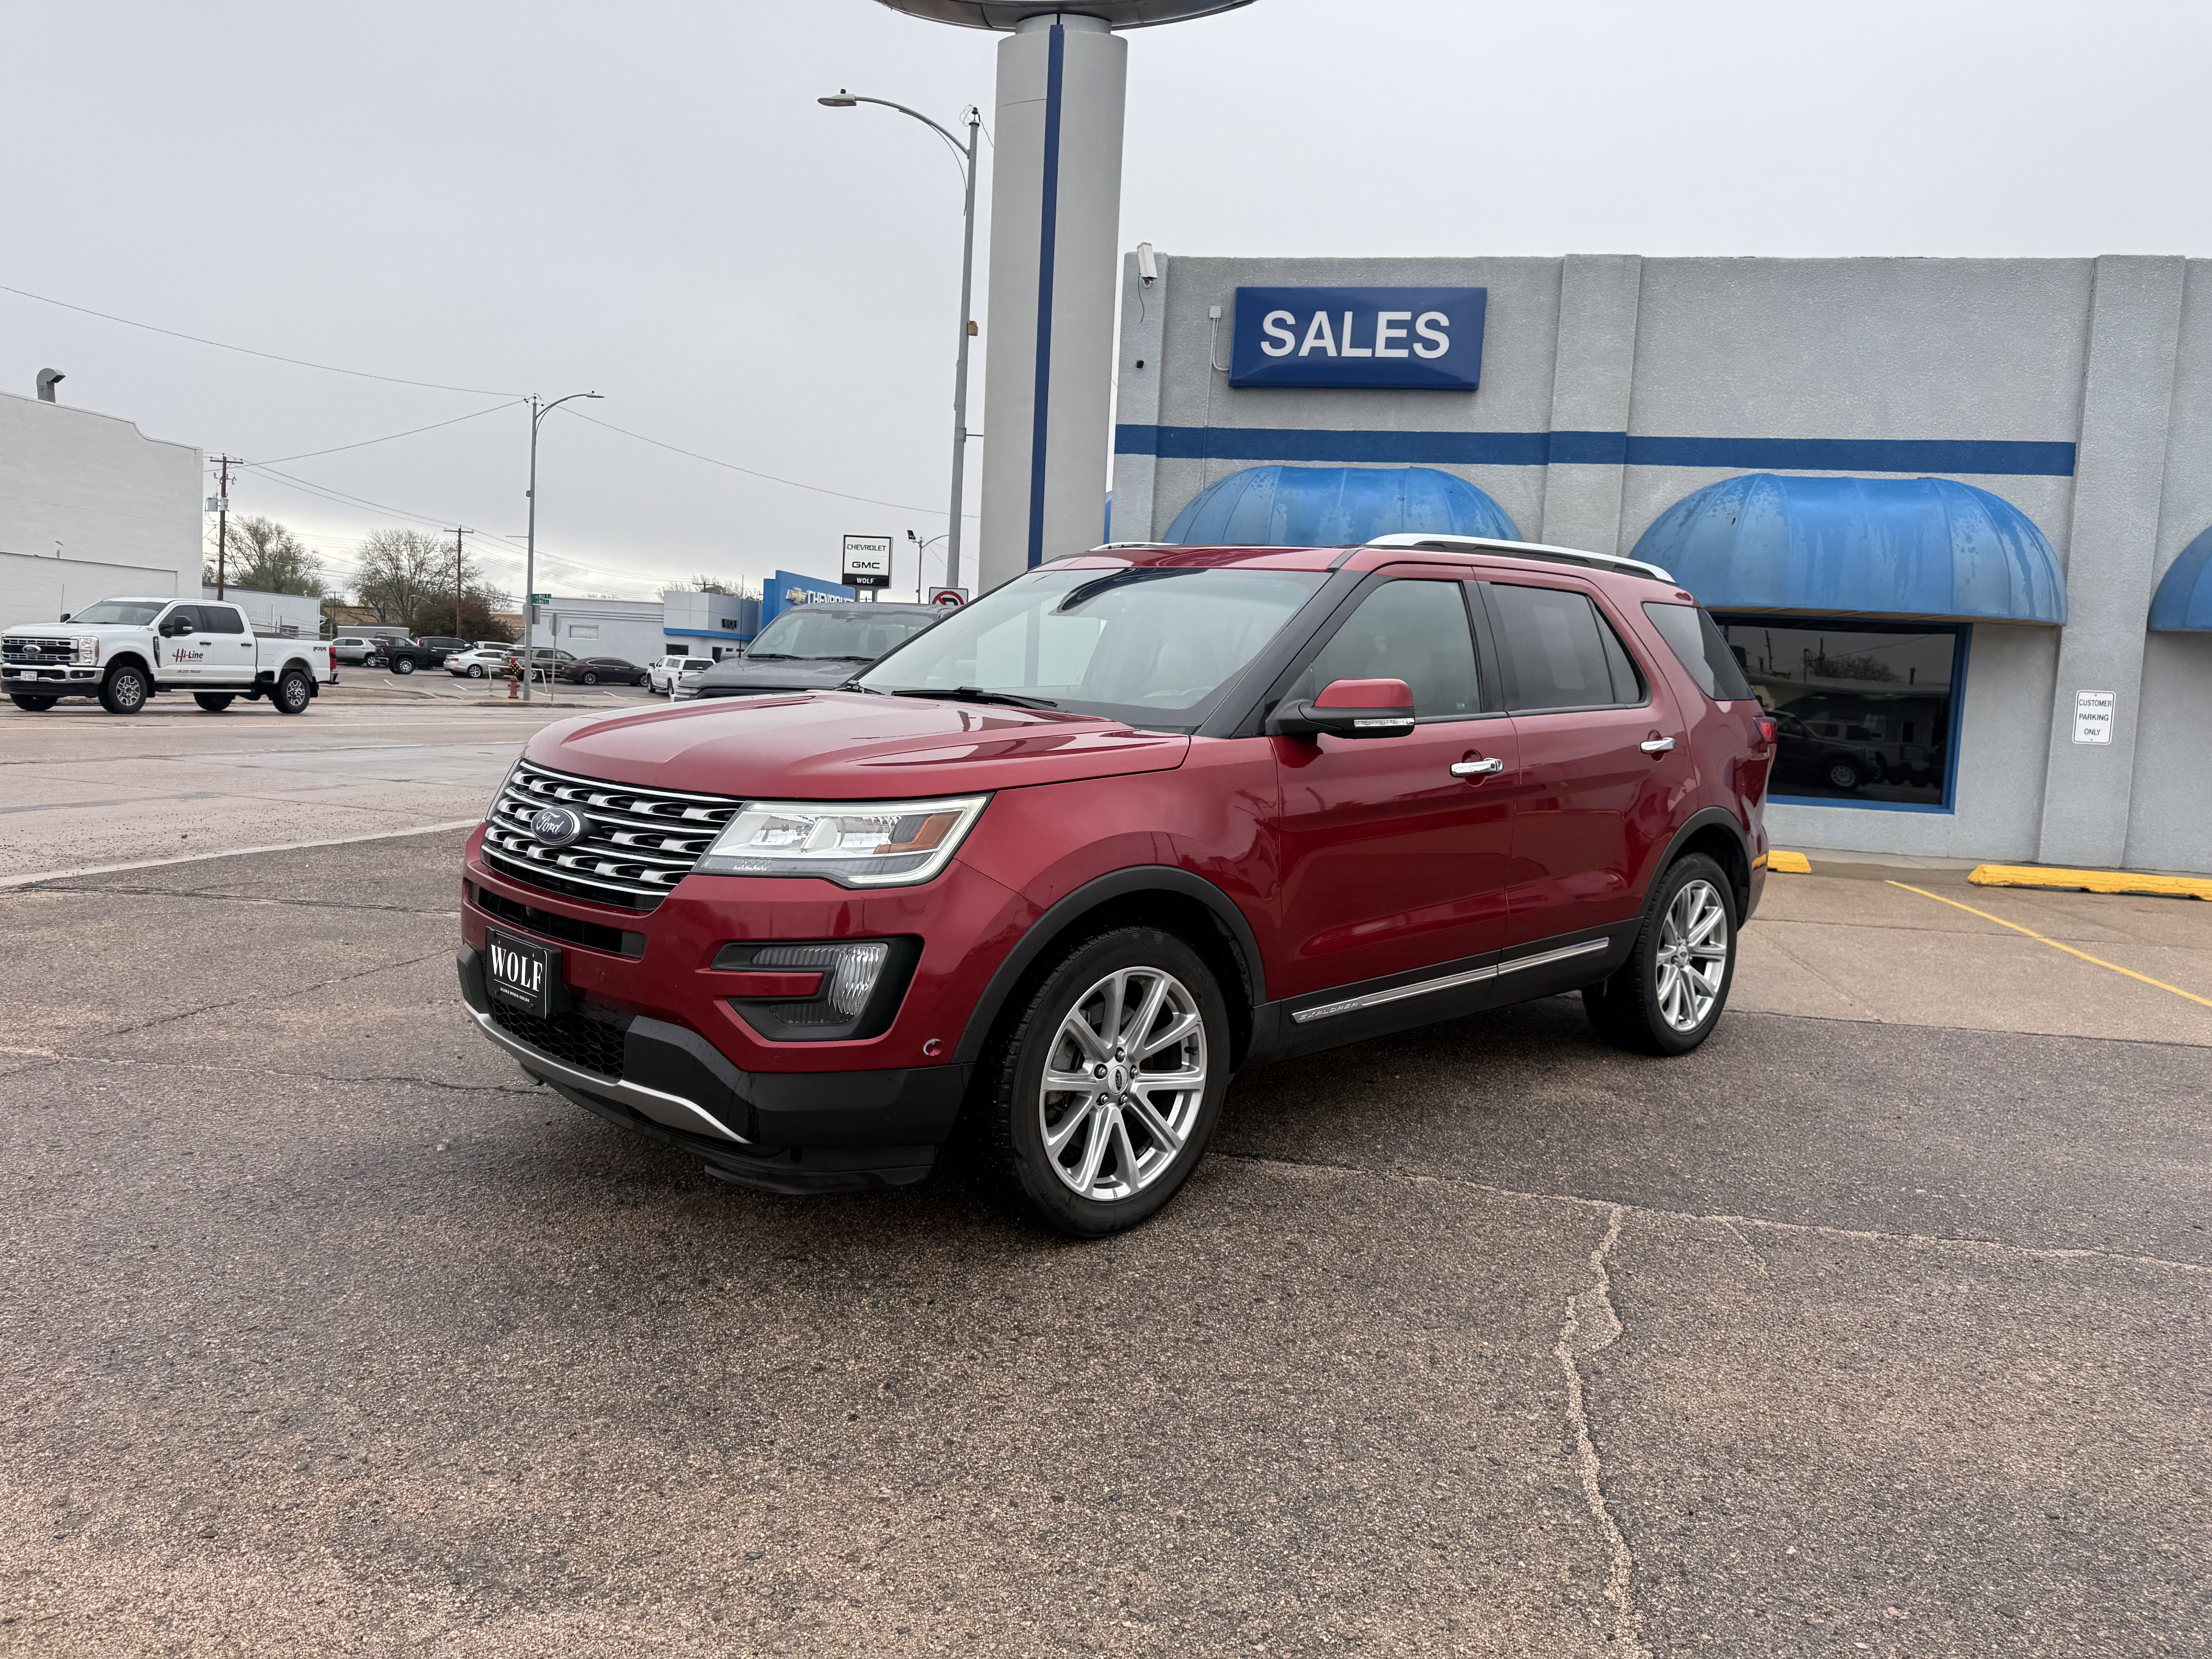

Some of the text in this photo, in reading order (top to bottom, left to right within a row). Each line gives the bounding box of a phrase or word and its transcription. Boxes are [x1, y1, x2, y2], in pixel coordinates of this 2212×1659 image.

[1261, 310, 1450, 359] SALES
[807, 590, 855, 604] CHEVRO
[2079, 713, 2109, 721] PARKING
[536, 812, 565, 835] Ford
[491, 944, 543, 992] WOLF
[1299, 1003, 1358, 1020] EXPLORER
